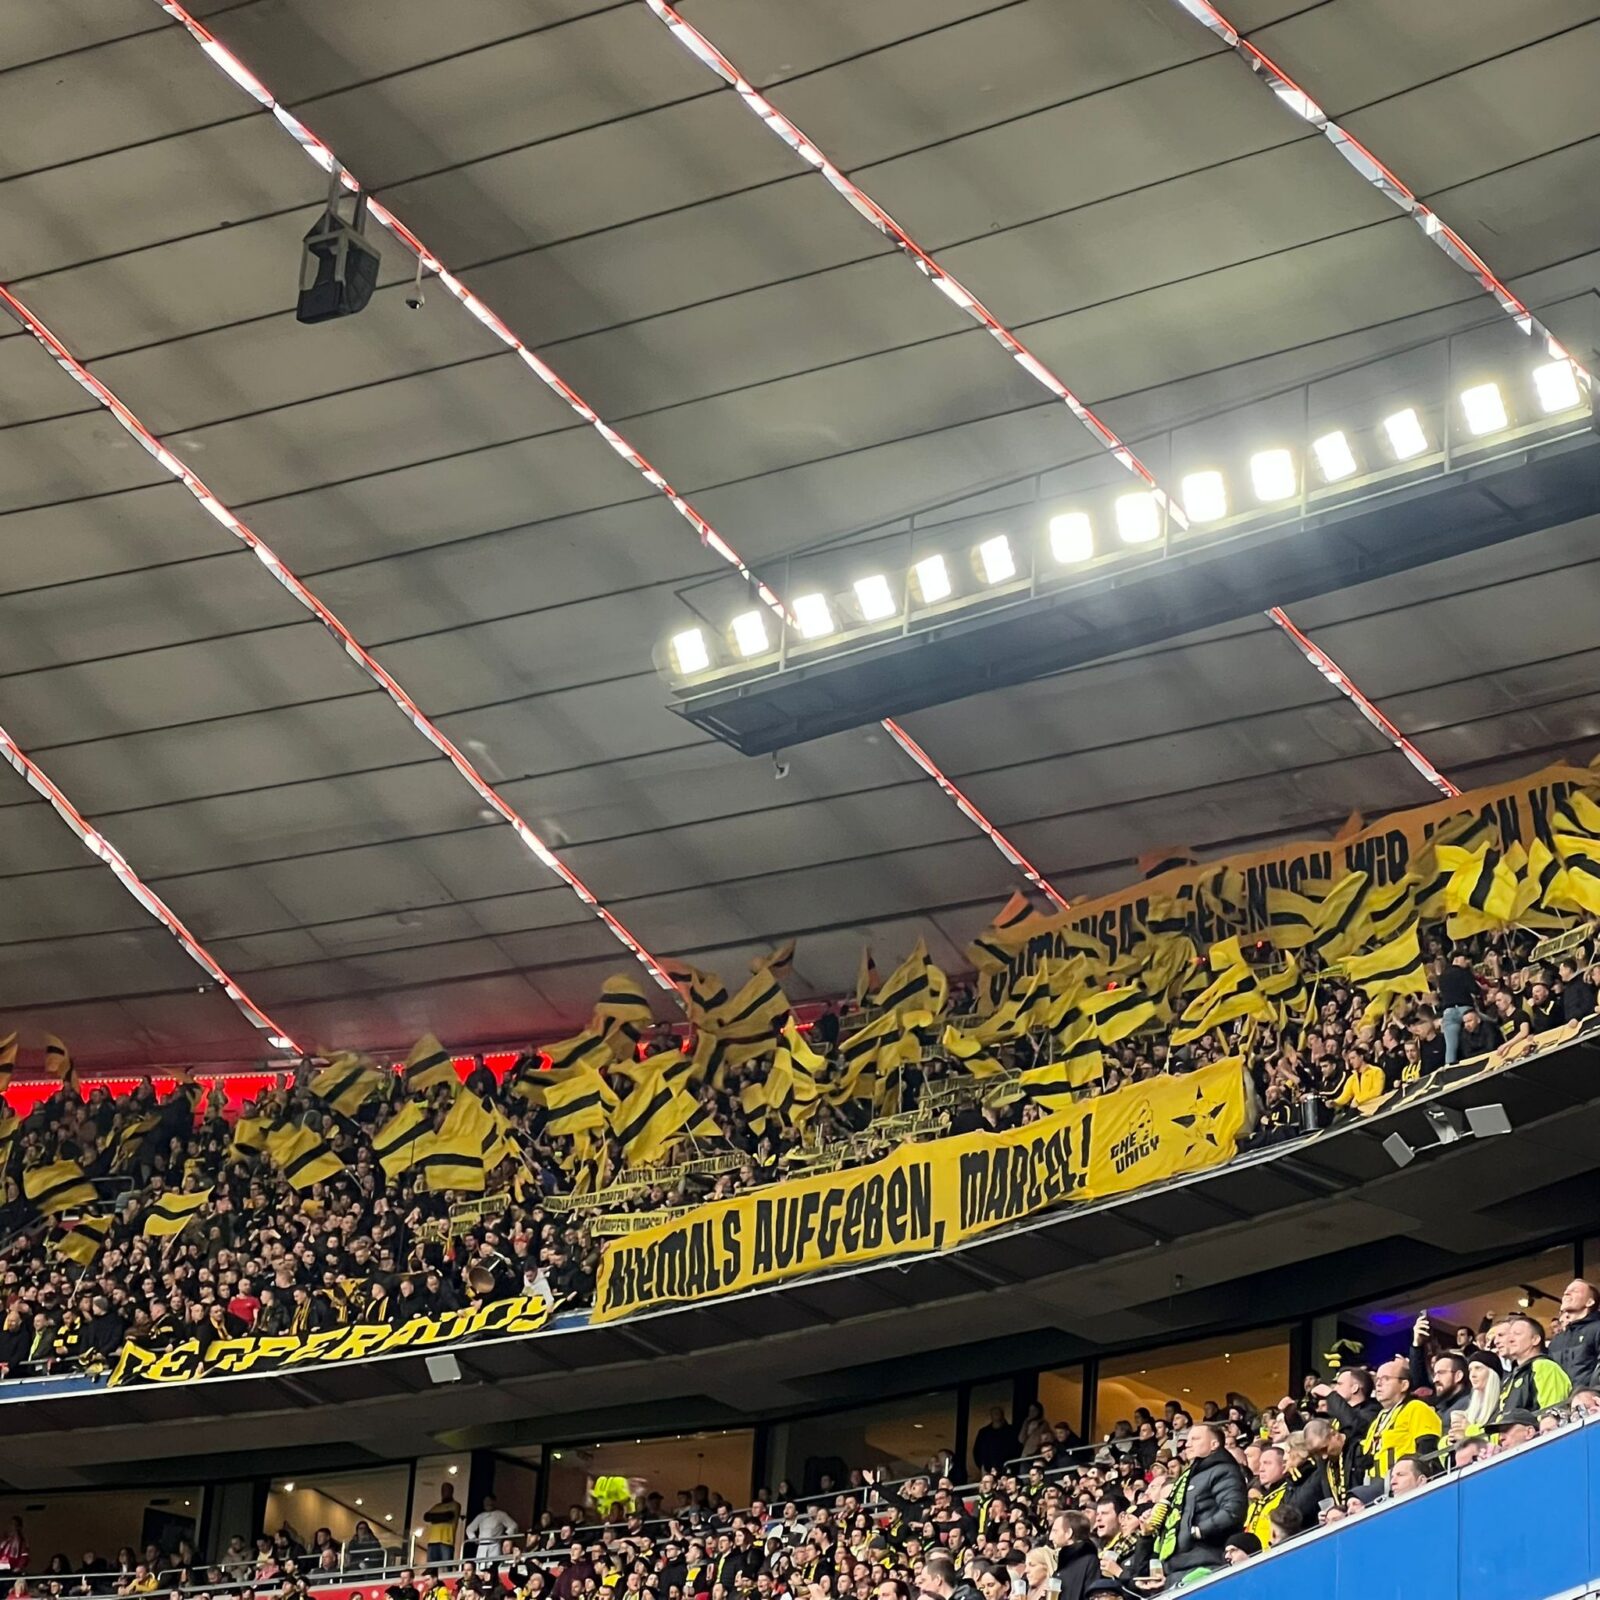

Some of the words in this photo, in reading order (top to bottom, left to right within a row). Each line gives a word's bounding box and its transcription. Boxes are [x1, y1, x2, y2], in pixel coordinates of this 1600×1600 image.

[602, 1209, 741, 1314] NIEMALS
[752, 1161, 946, 1276] AUFGEBEN,
[960, 1113, 1093, 1231] MARCEL!
